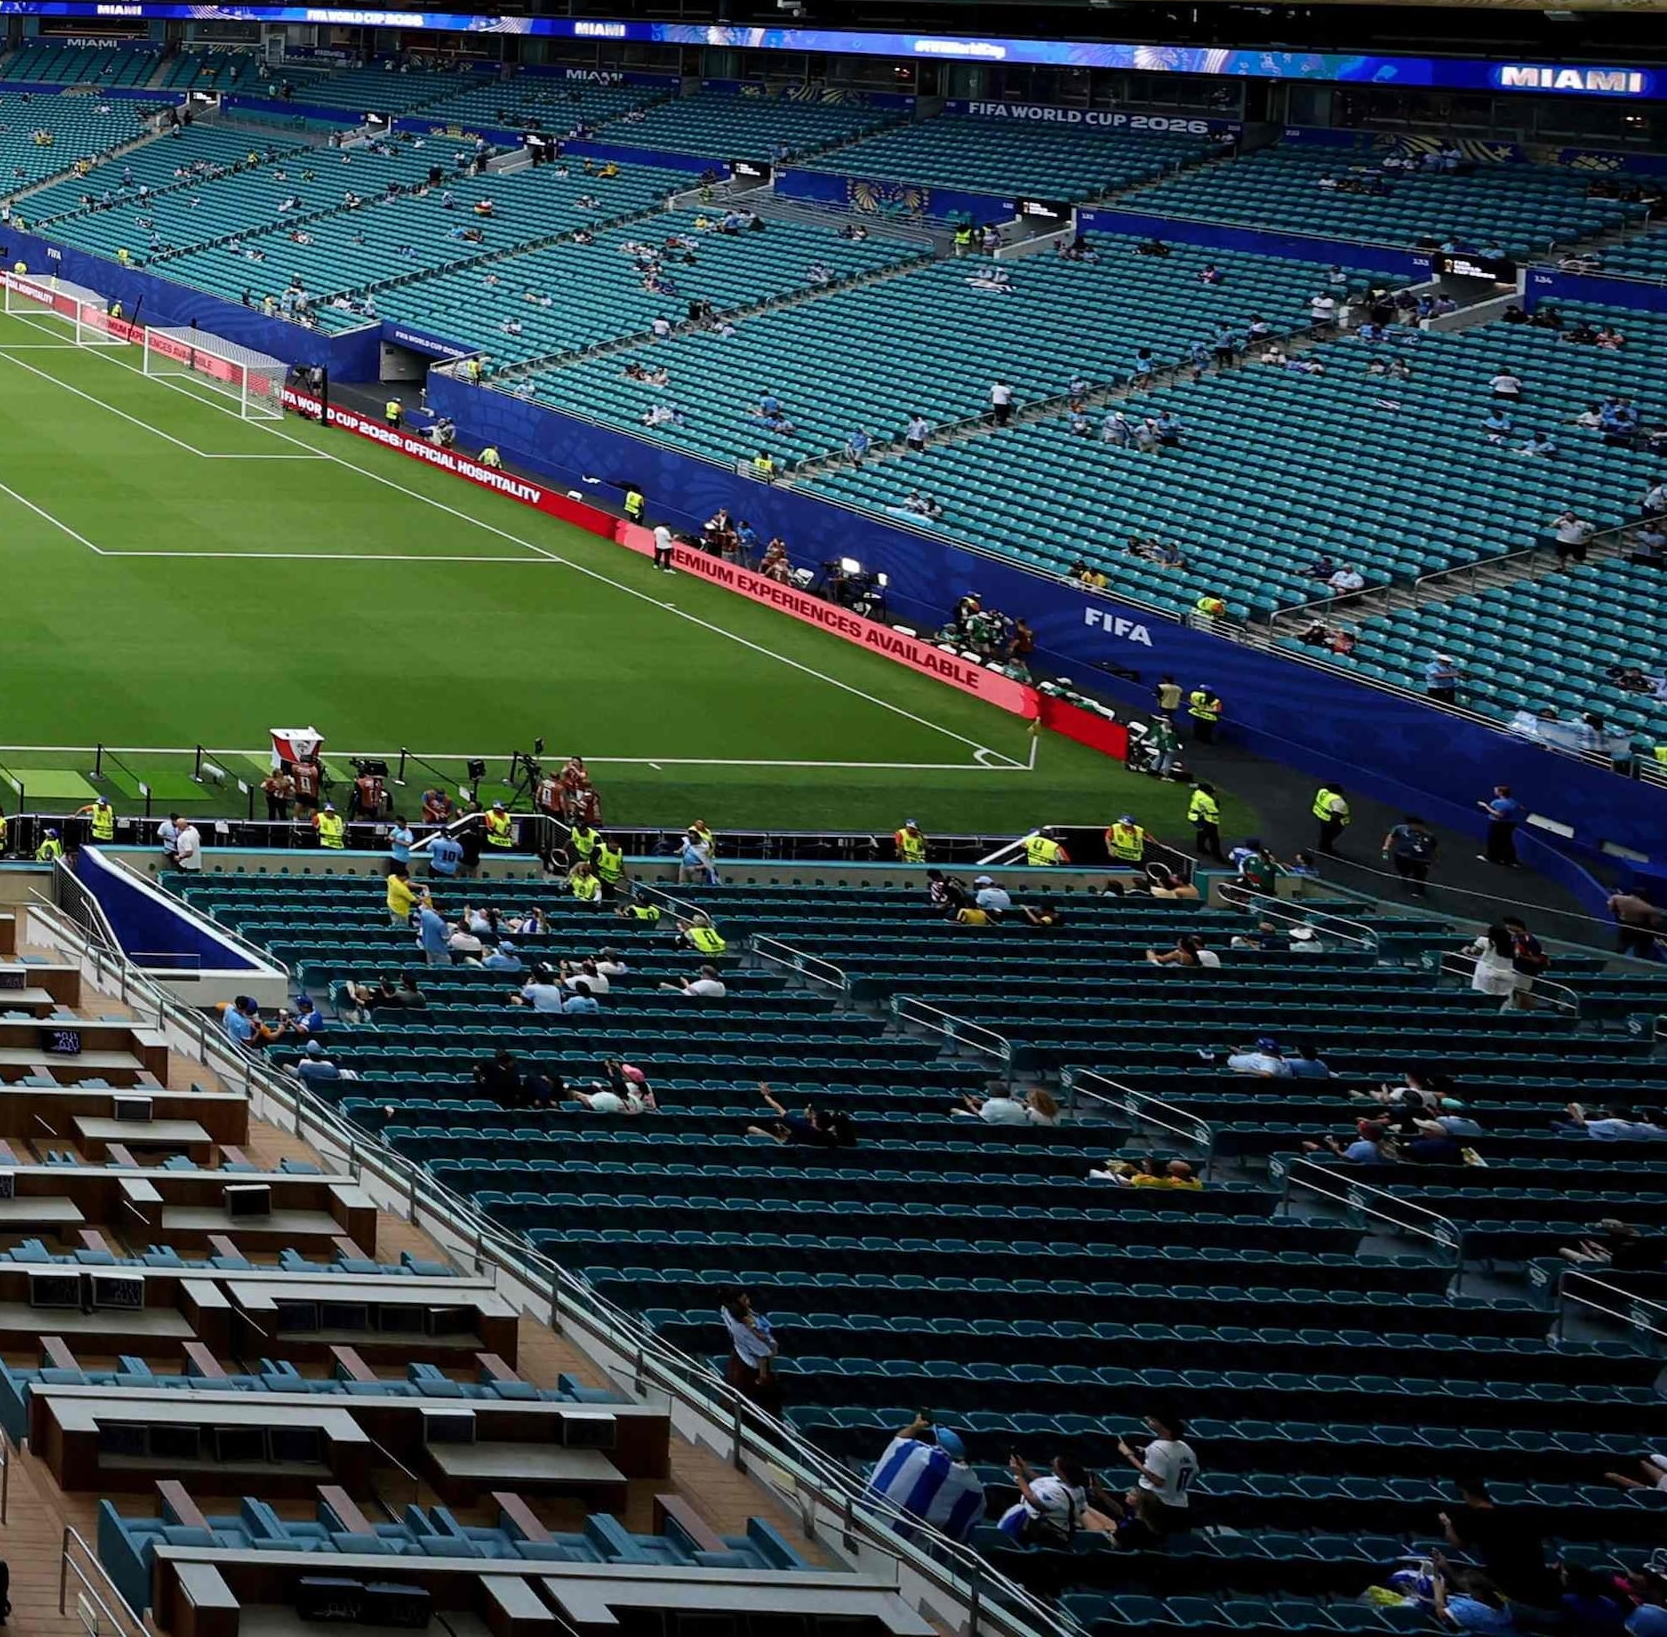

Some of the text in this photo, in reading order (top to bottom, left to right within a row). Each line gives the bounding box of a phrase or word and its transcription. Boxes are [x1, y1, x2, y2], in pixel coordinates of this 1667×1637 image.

[97, 5, 142, 15] MIAMI
[575, 22, 626, 37] MIAMI
[67, 39, 118, 48] MIAMI
[1501, 66, 1642, 94] MIAMI
[969, 101, 1008, 117] FIFA
[1011, 105, 1082, 123] WORLD
[1085, 112, 1127, 126] CUP
[1130, 116, 1209, 134] 2026
[47, 247, 62, 260] FIFA
[298, 395, 335, 420] WORD
[336, 411, 359, 428] CUP
[359, 421, 401, 446] 2026
[404, 439, 457, 470] OFFICIAL
[457, 459, 541, 503] HOSPITALITY
[672, 550, 979, 689] EMIUM EXPERIENCES AVAILABLE
[1085, 606, 1153, 647] FIFA
[441, 850, 456, 861] 10
